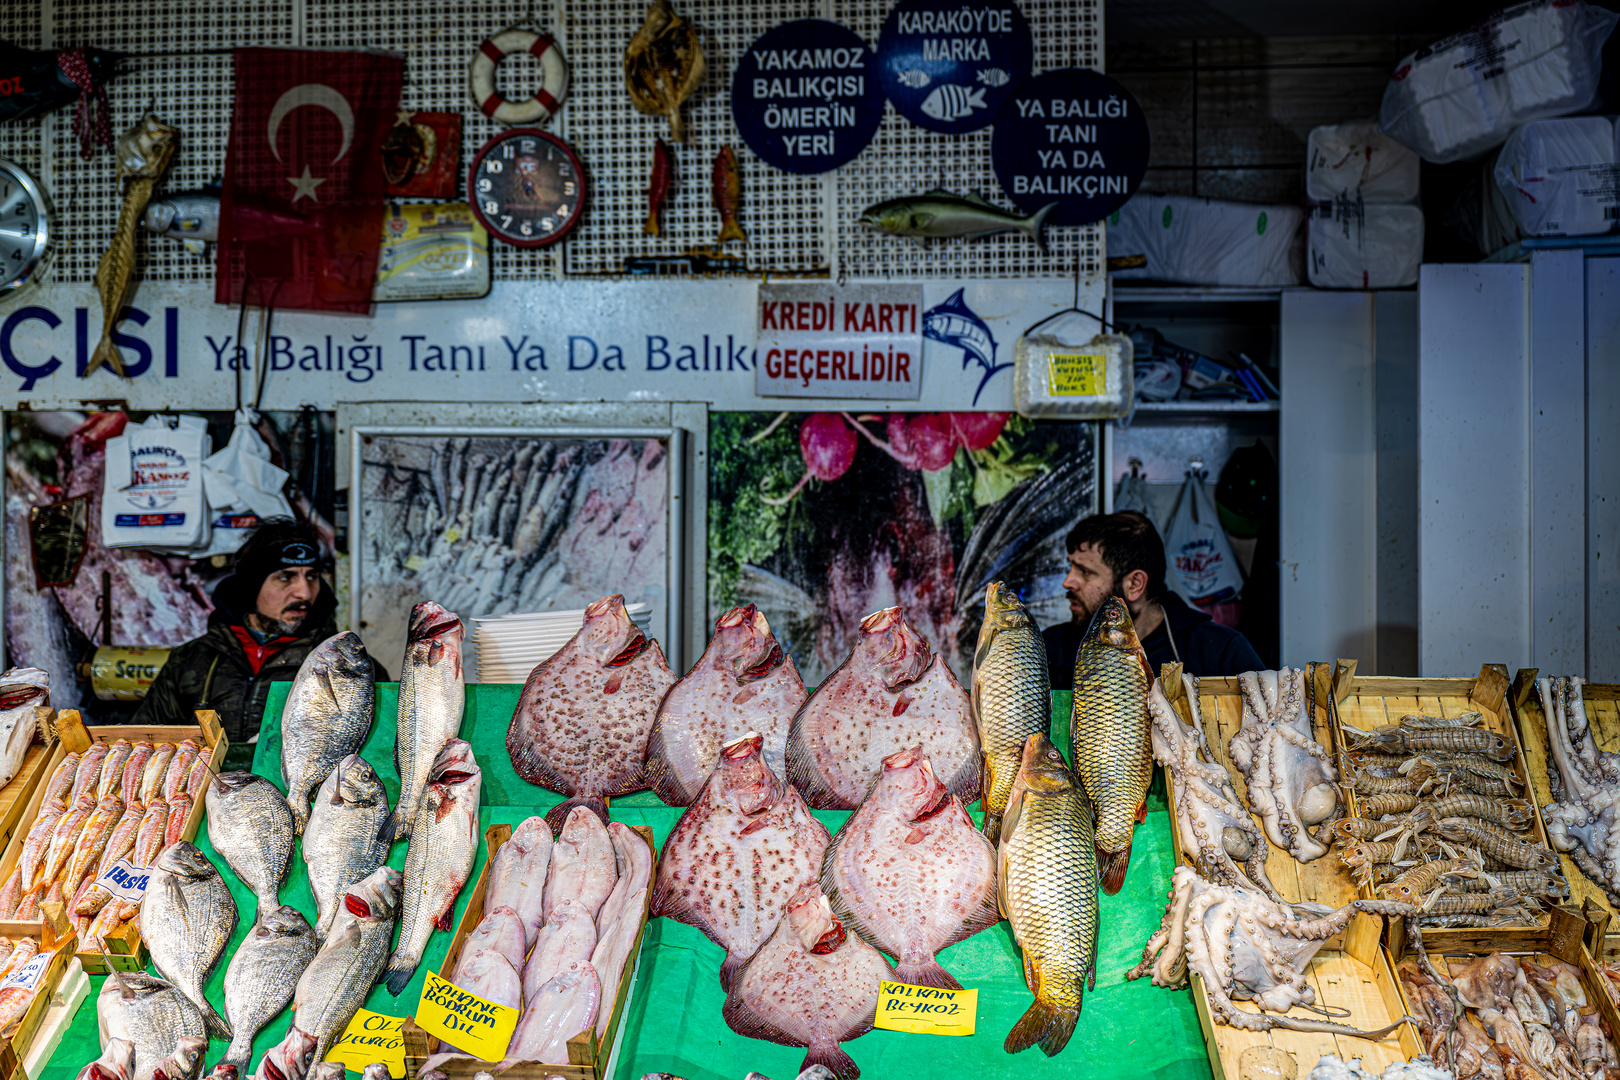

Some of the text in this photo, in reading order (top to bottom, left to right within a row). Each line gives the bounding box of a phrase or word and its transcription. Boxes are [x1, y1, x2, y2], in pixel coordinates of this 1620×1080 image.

[897, 5, 1012, 34] KARAKÖY'DE
[923, 39, 991, 61] MARKA
[753, 48, 864, 71] YAKAMOZ
[753, 76, 864, 102] BALIKÇISI
[1016, 94, 1128, 118] YA BALIĞI
[764, 102, 855, 128] ÖMER'İN
[782, 130, 834, 155] YERİ
[1046, 125, 1097, 144] TANI
[503, 145, 514, 159] 11
[520, 140, 536, 153] 12
[547, 146, 554, 160] 1
[486, 160, 503, 174] 10
[1037, 150, 1105, 169] YA DA
[559, 162, 570, 176] 2
[480, 179, 492, 192] 9
[564, 181, 575, 196] 3
[1013, 176, 1128, 198] BALIKÇINI
[15, 202, 26, 216] 2
[485, 201, 498, 215] 8
[556, 203, 569, 218] 4
[21, 223, 30, 236] 3
[501, 215, 513, 229] 7
[520, 219, 533, 236] 6
[541, 217, 553, 231] 5
[11, 248, 22, 260] 4
[763, 298, 916, 334] KREDİ KARTI
[205, 336, 252, 371] Ya
[270, 334, 383, 382] Balığı
[401, 335, 486, 372] Tanı
[501, 335, 549, 372] Ya
[567, 335, 627, 372] Da
[645, 335, 757, 372] Balık
[766, 345, 911, 387] GEÇERLİDİR
[882, 982, 956, 1000] KALKAN
[423, 989, 496, 1028] BODRUM
[885, 999, 966, 1015] BEYKOZ
